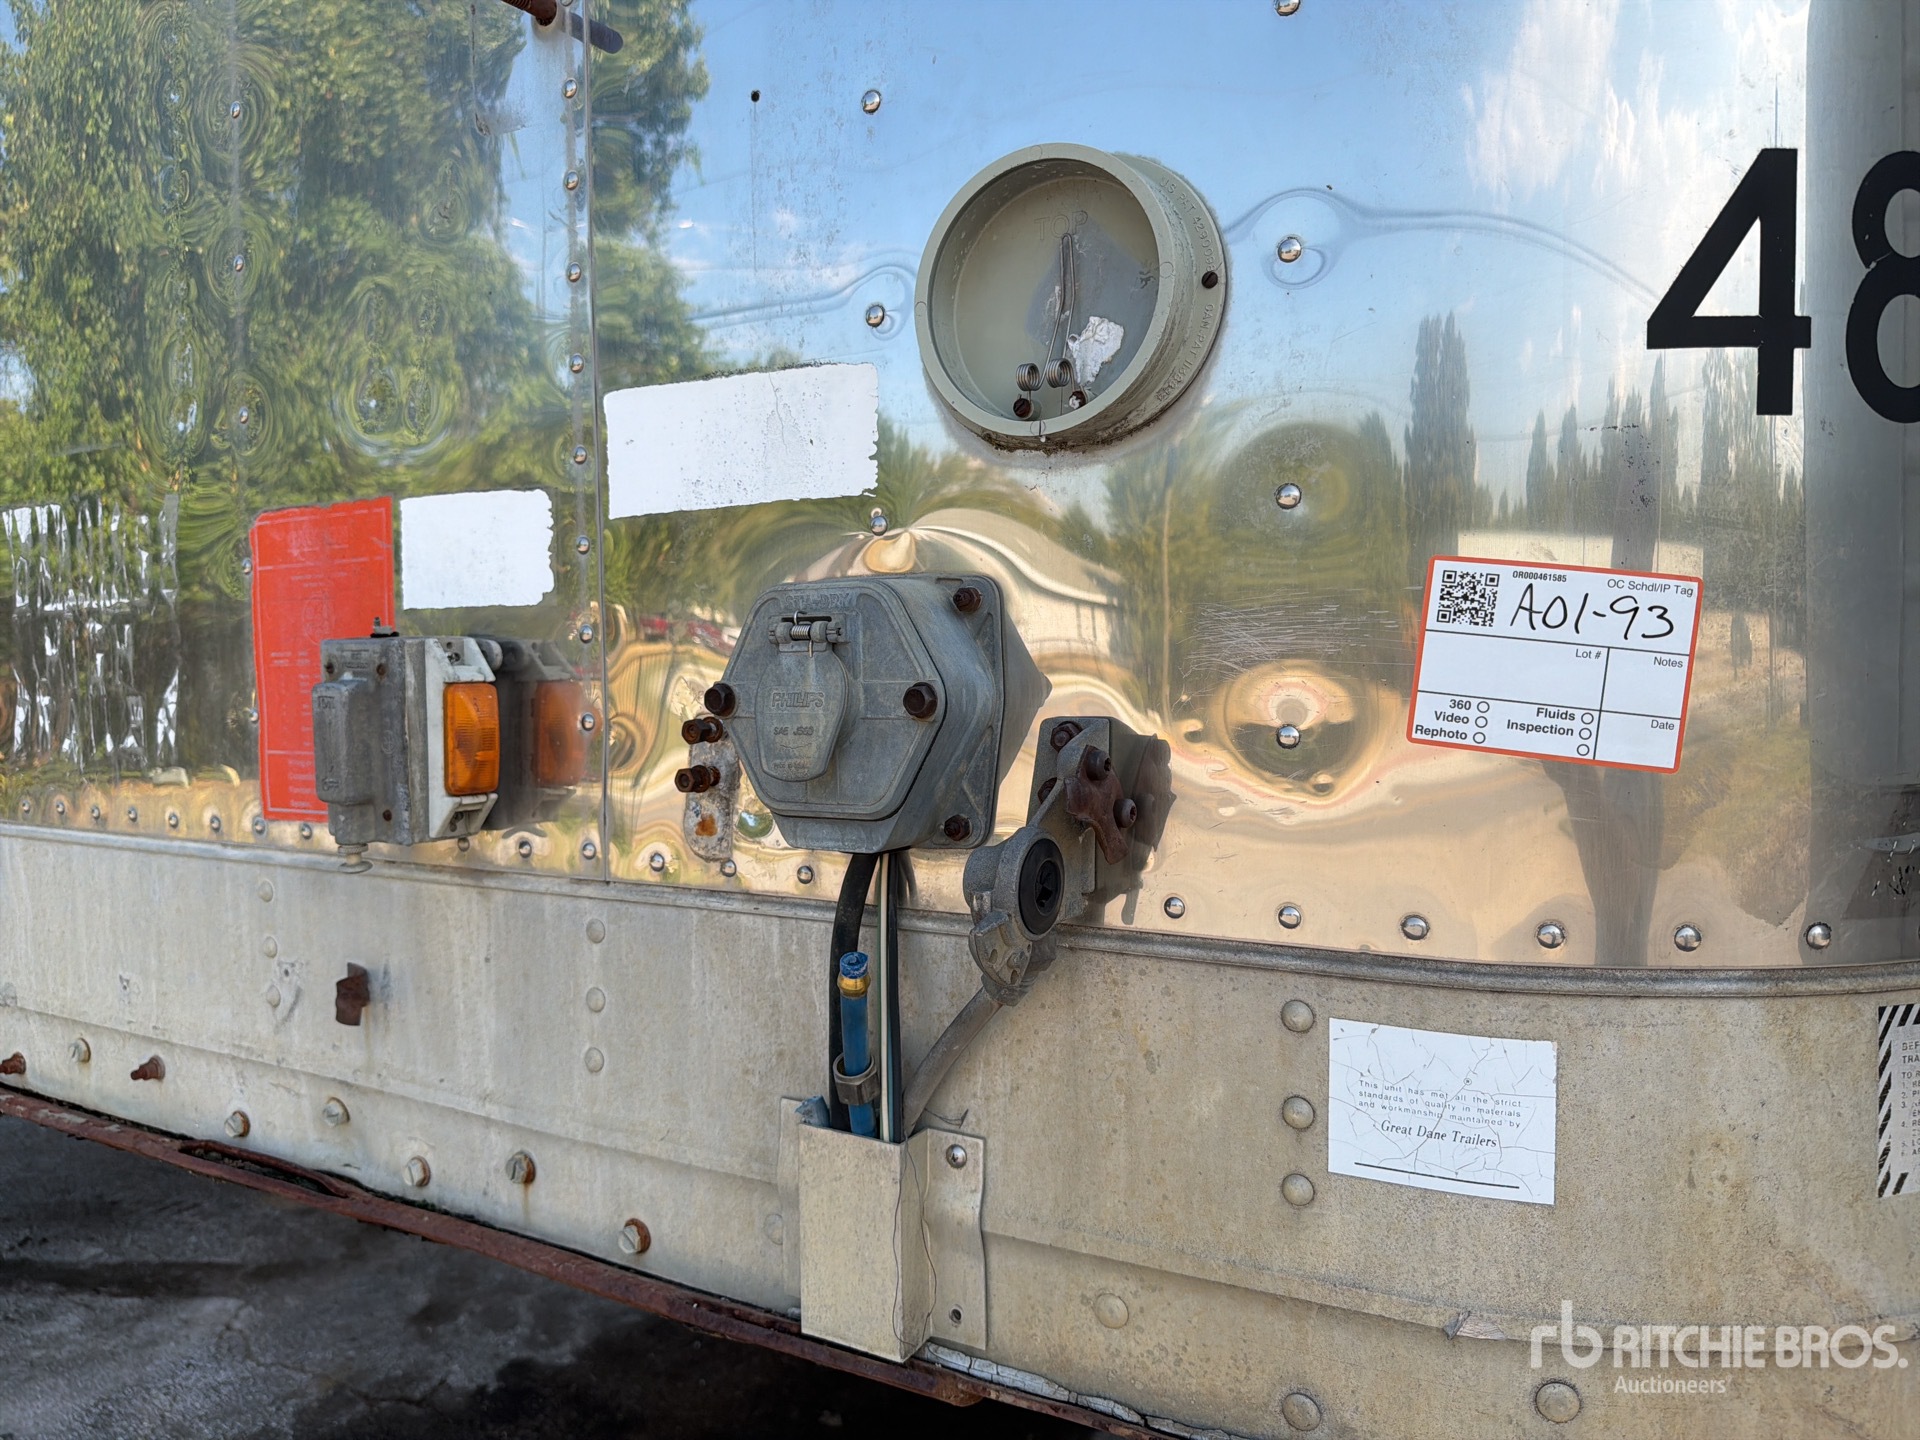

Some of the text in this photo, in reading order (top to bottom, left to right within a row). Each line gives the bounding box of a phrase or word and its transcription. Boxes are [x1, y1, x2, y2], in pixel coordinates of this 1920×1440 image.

[1033, 210, 1089, 242] TOP
[1607, 578, 1694, 598] OC Schdl/IP Tag
[1575, 649, 1601, 660] Lot #
[1653, 657, 1684, 668] Notes
[771, 691, 825, 708] PHILLIPS
[1449, 699, 1472, 711] 360
[1434, 710, 1470, 725] Video
[1536, 707, 1576, 721] Fluids
[1414, 724, 1468, 742] Rephoto
[1506, 719, 1574, 738] Inspection
[1650, 719, 1675, 731] Date
[1359, 1080, 1378, 1089] This
[1384, 1085, 1402, 1093] unit
[1408, 1088, 1425, 1096] has
[1430, 1091, 1448, 1100] met
[1473, 1096, 1488, 1104] the
[1495, 1099, 1521, 1108] strict
[1359, 1090, 1403, 1103] standards
[1424, 1100, 1456, 1111] quality
[1477, 1107, 1521, 1118] materials
[1359, 1100, 1521, 1128] and workmanship maintained by
[1381, 1119, 1497, 1148] Great Dane Trailers
